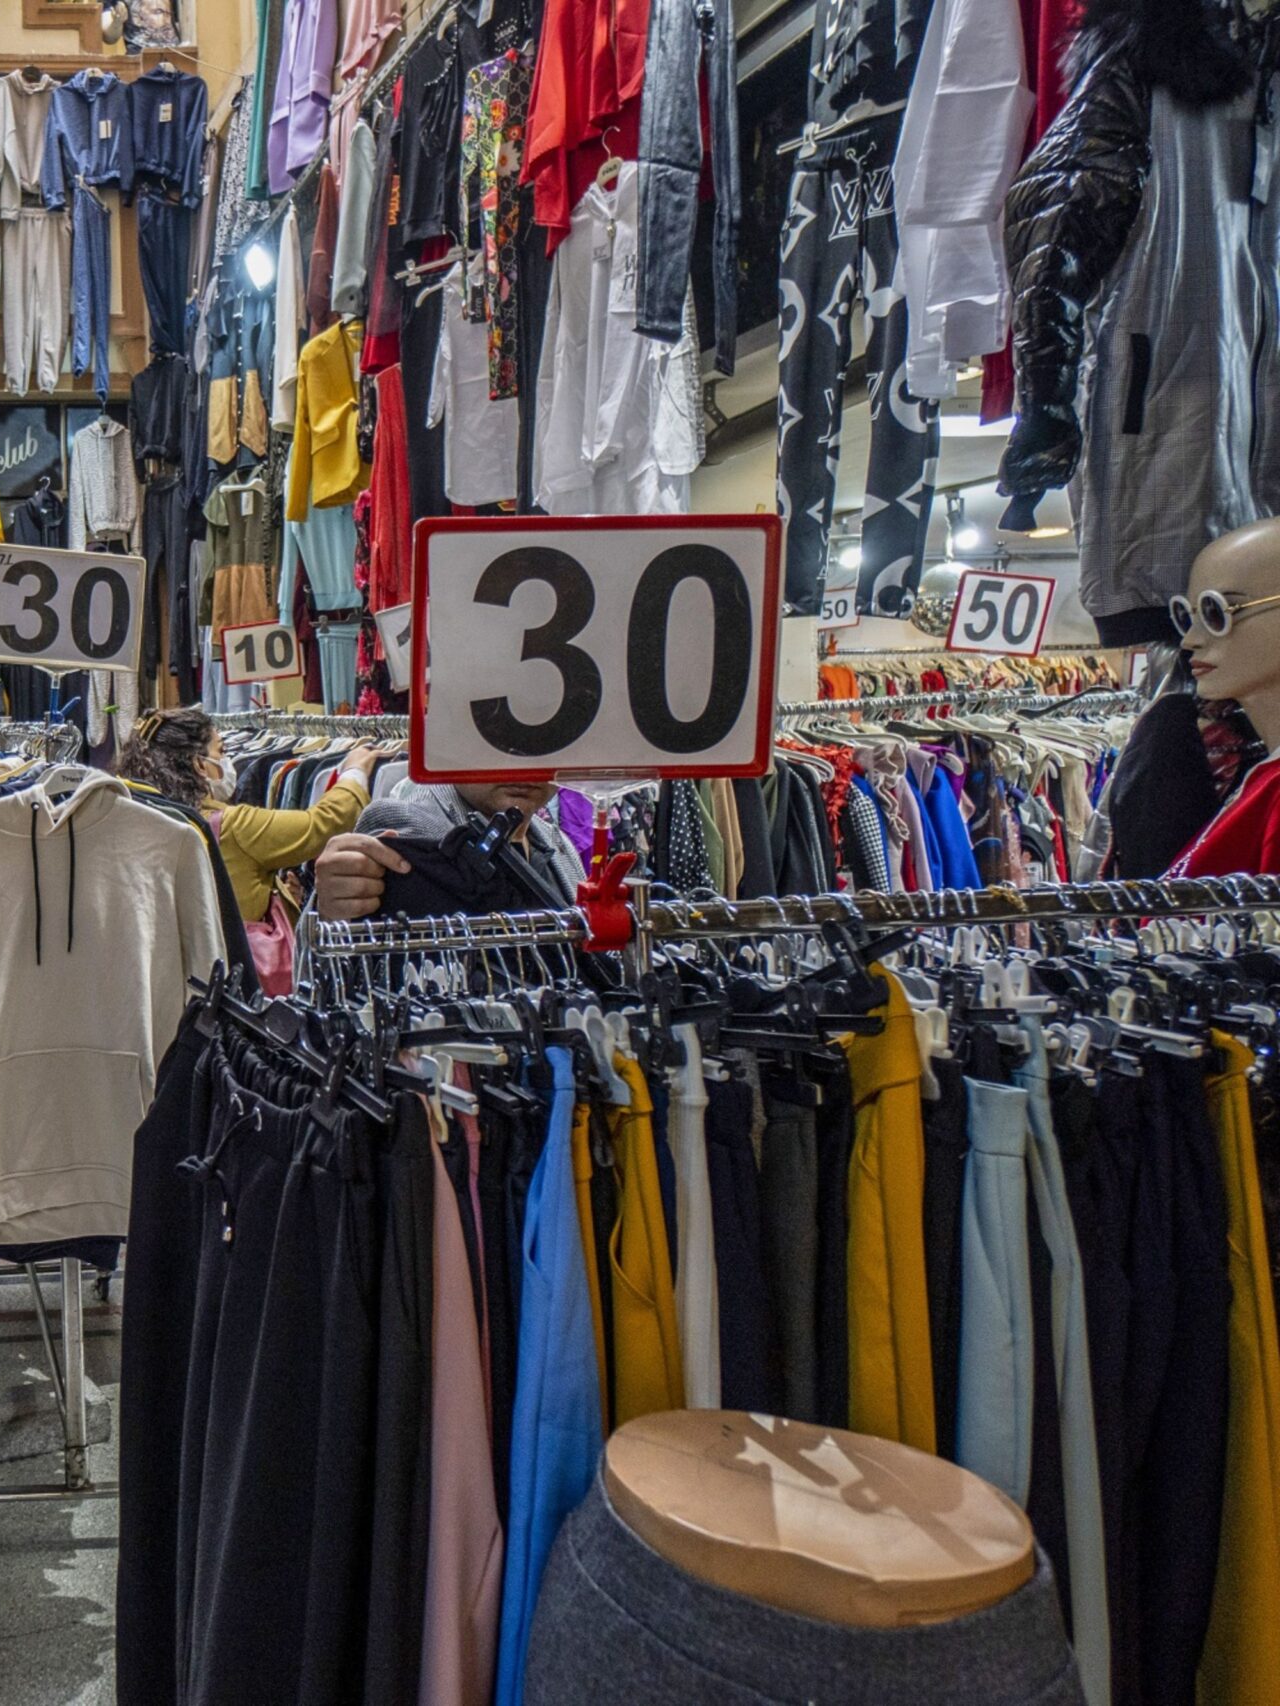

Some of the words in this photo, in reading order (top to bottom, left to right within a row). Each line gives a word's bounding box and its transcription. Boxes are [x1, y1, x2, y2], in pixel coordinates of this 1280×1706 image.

[821, 599, 848, 621] 50
[963, 579, 1039, 645] 50
[234, 630, 293, 672] 10
[469, 543, 753, 757] 30
